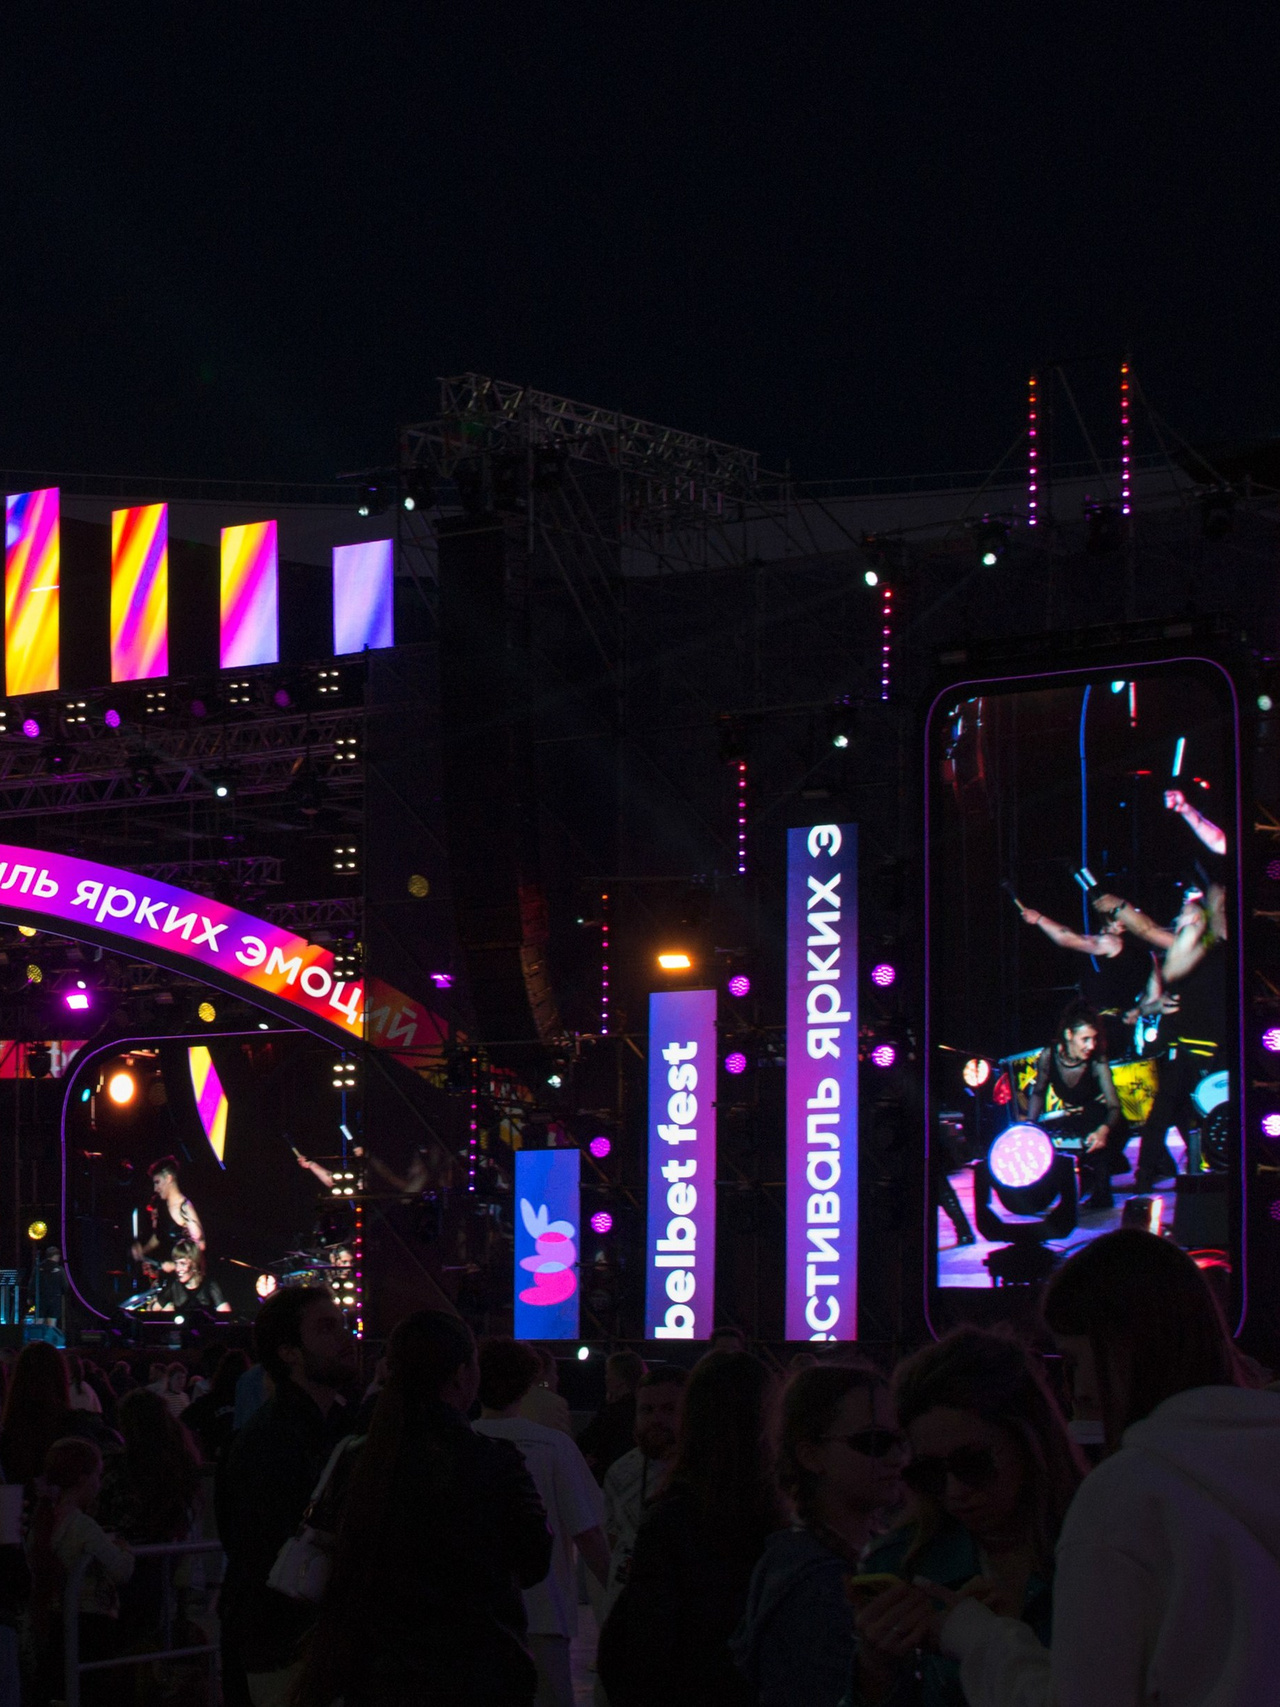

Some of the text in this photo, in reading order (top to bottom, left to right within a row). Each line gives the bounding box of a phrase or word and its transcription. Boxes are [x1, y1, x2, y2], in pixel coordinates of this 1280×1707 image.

[70, 879, 228, 953] ярких
[806, 872, 851, 1060] ярких
[654, 1040, 698, 1339] belbet fest
